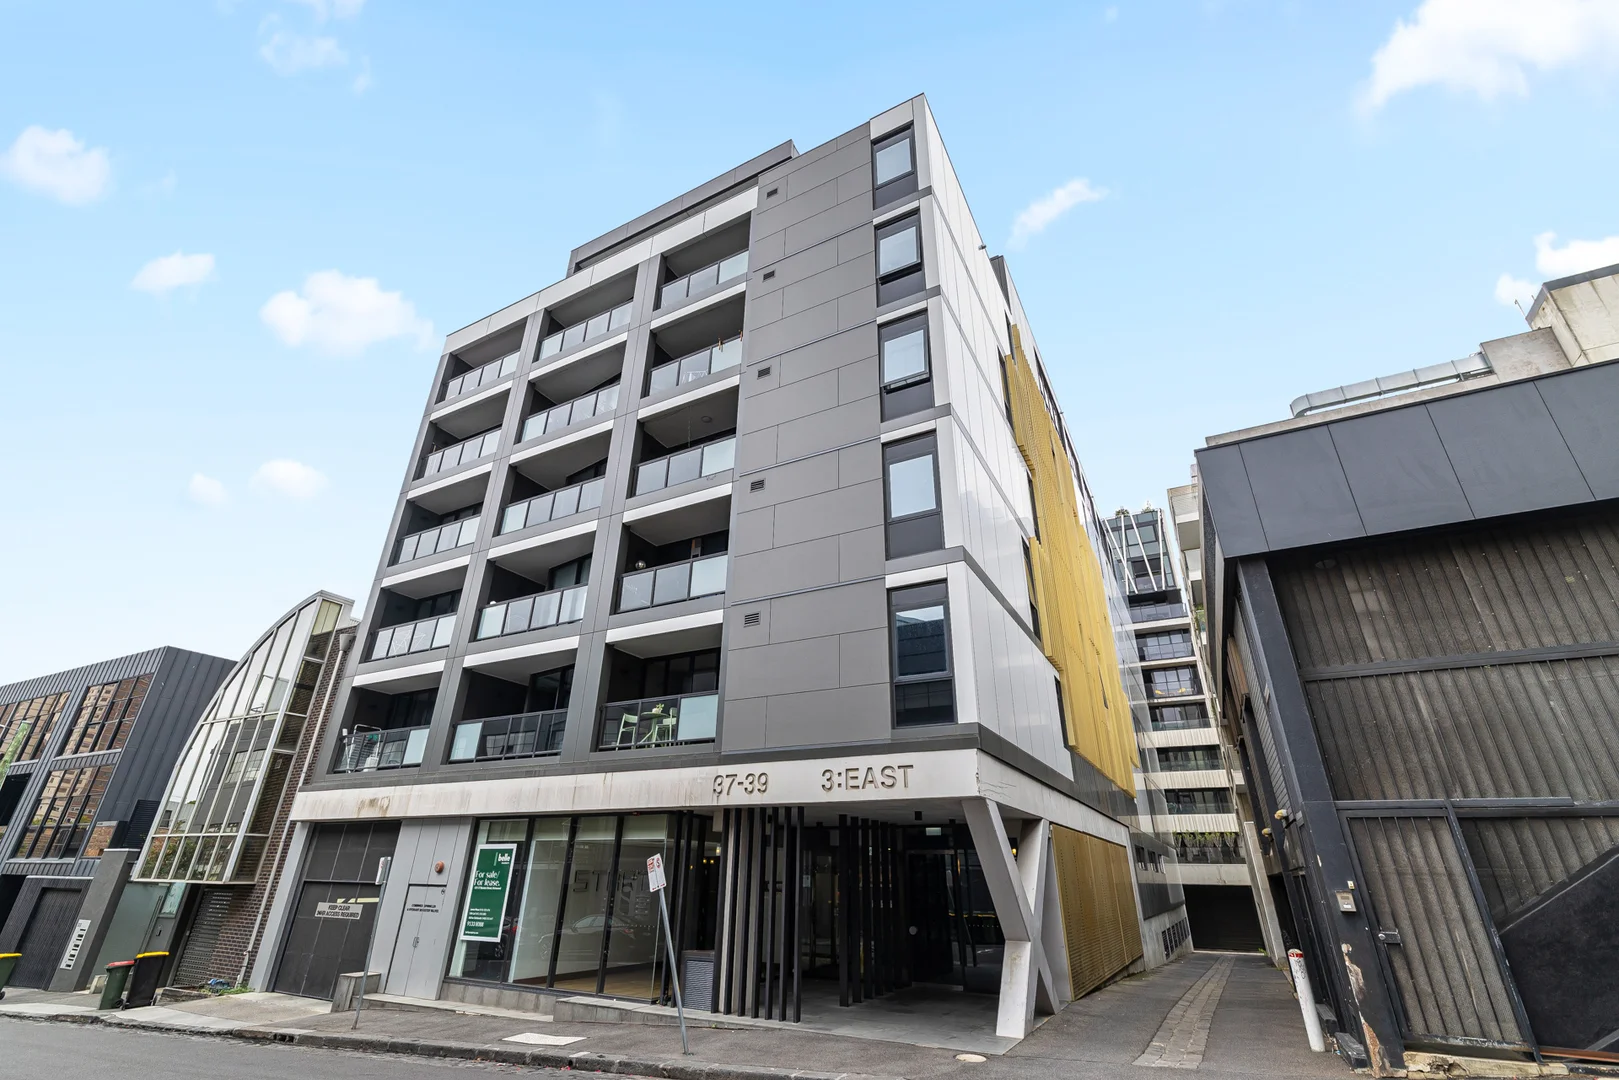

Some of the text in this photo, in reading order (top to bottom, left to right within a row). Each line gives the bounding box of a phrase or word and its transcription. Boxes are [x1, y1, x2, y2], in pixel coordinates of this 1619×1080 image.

[821, 764, 914, 792] 3:EAST
[712, 772, 769, 796] 37-39
[498, 853, 510, 862] belle
[475, 870, 485, 878] For
[473, 878, 484, 886] For
